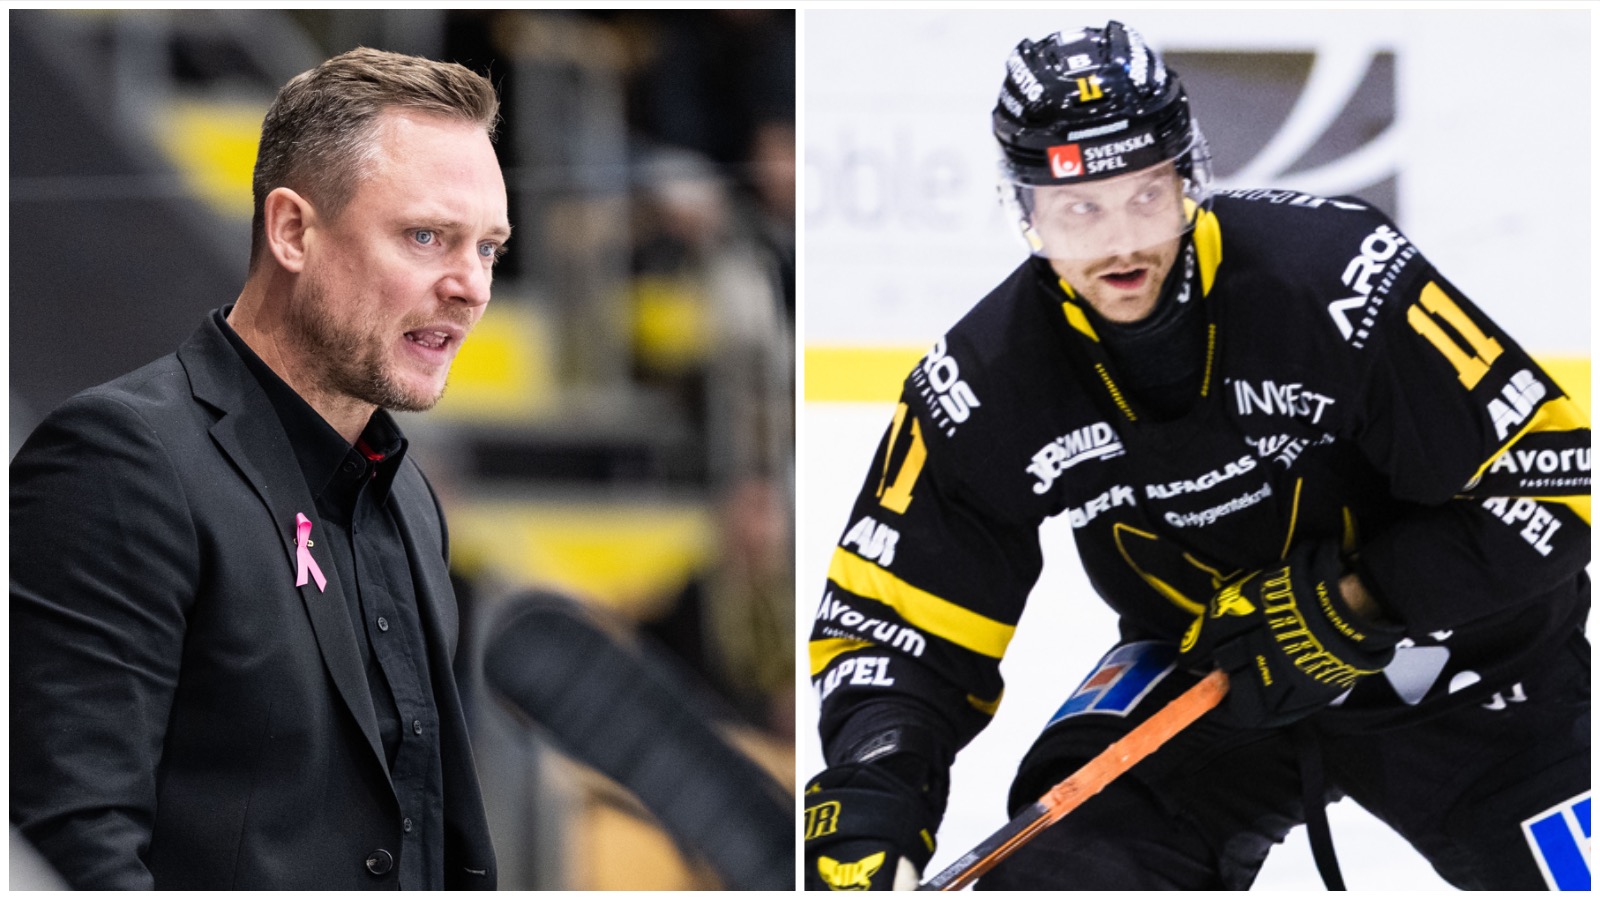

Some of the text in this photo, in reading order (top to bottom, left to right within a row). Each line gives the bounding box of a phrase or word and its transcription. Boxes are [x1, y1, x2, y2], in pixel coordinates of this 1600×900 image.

[1084, 132, 1156, 161] SVENSKA
[1086, 155, 1129, 174] SPEL
[1406, 280, 1505, 392] 11
[1145, 454, 1258, 500] ALFAGLAS
[817, 591, 927, 658] Avorum
